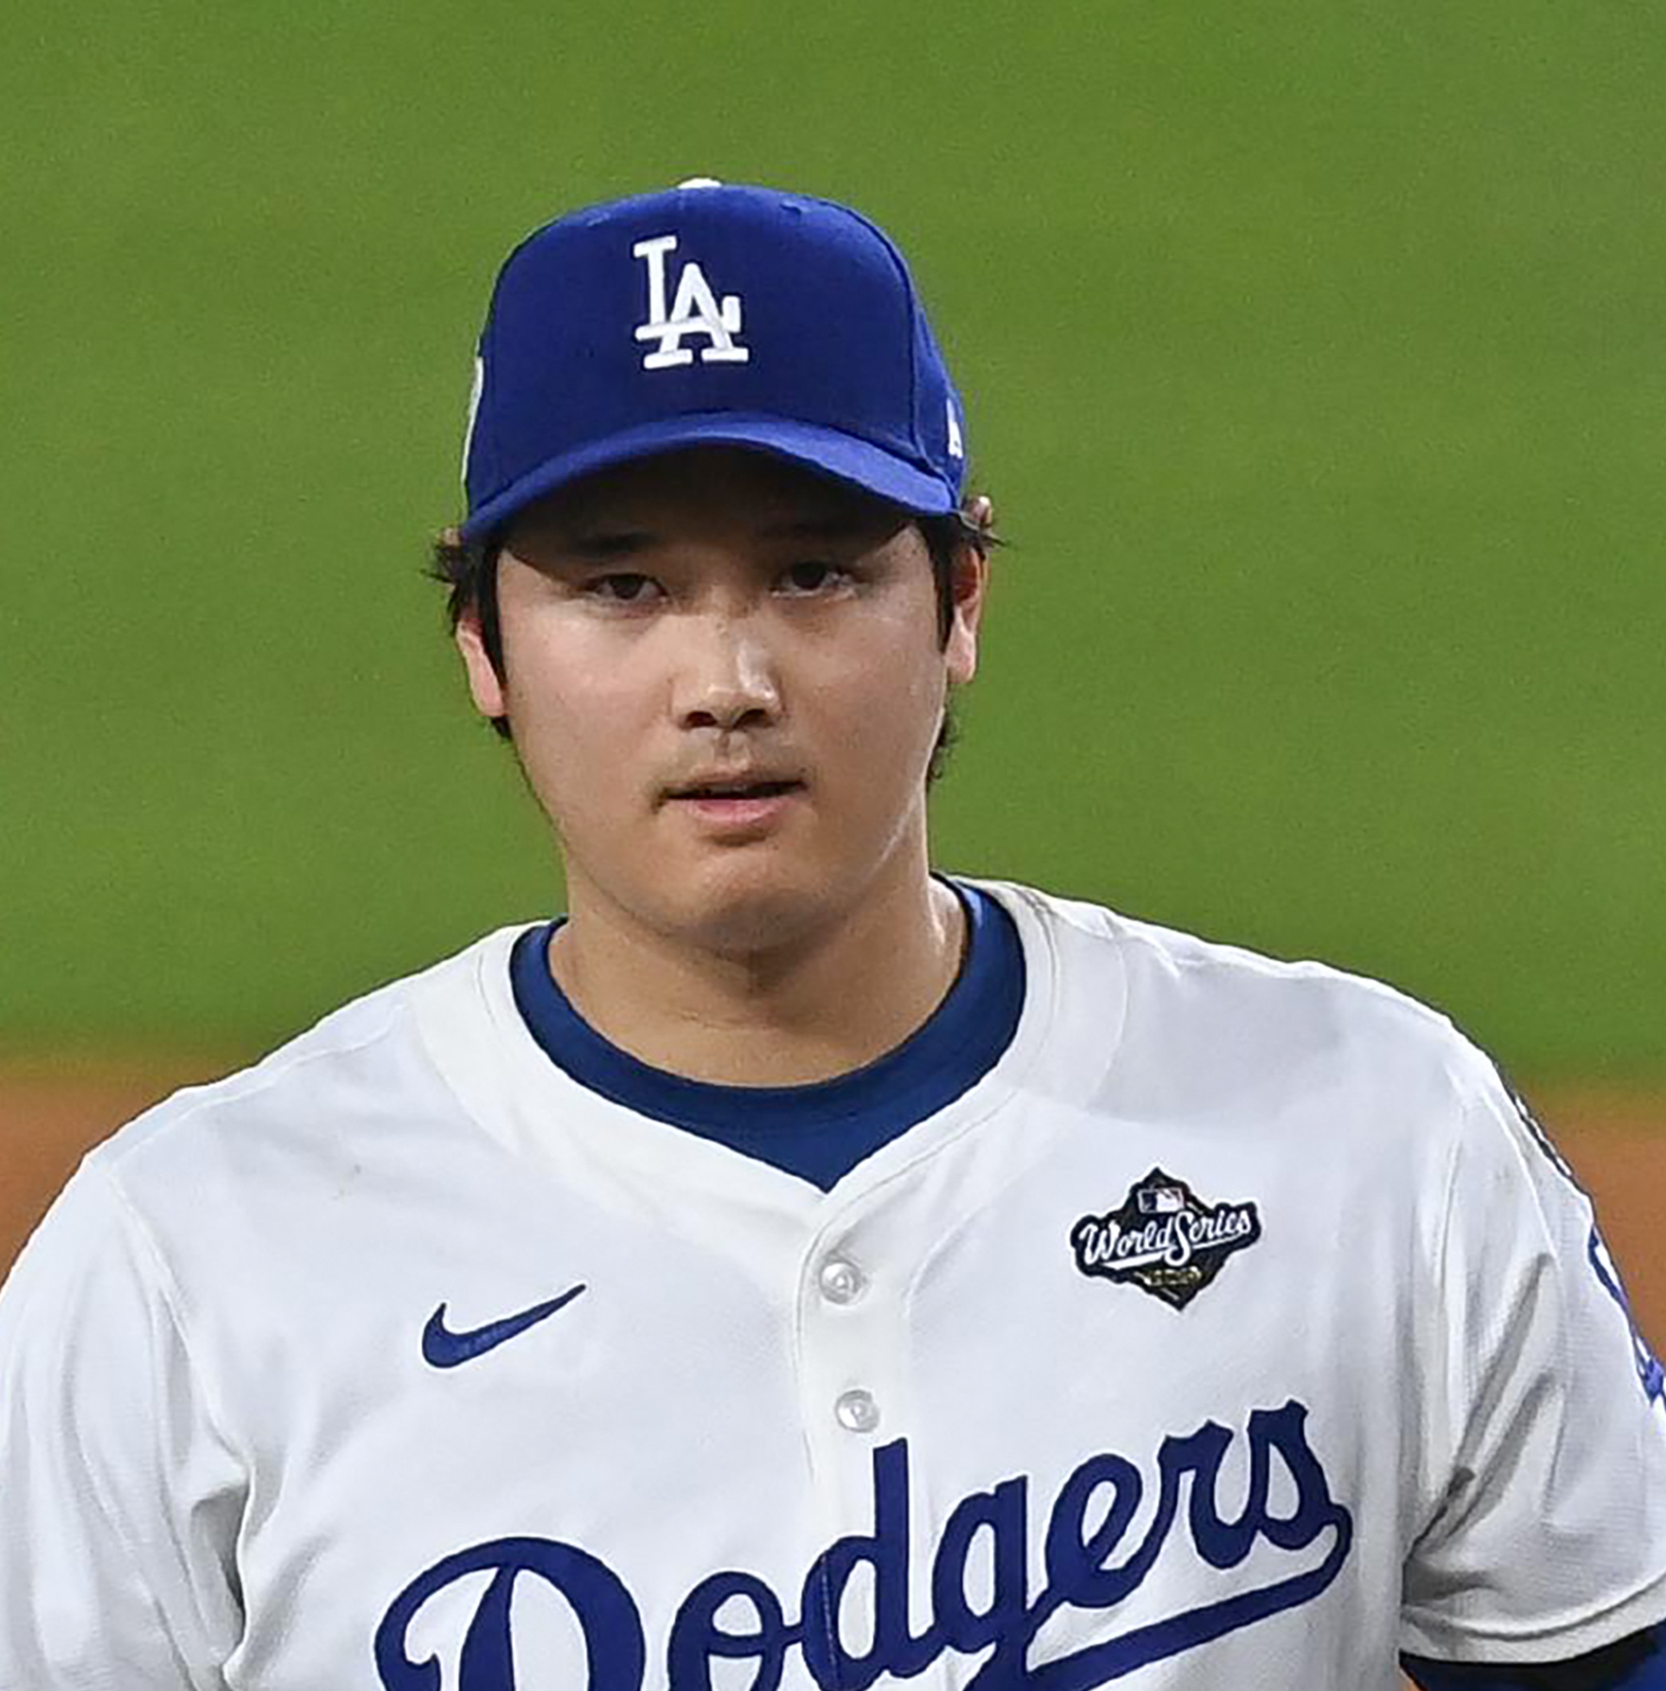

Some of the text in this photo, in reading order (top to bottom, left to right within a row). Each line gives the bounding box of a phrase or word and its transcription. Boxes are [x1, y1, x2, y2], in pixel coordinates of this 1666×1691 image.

[633, 235, 749, 369] LA
[1078, 1210, 1252, 1266] World Series
